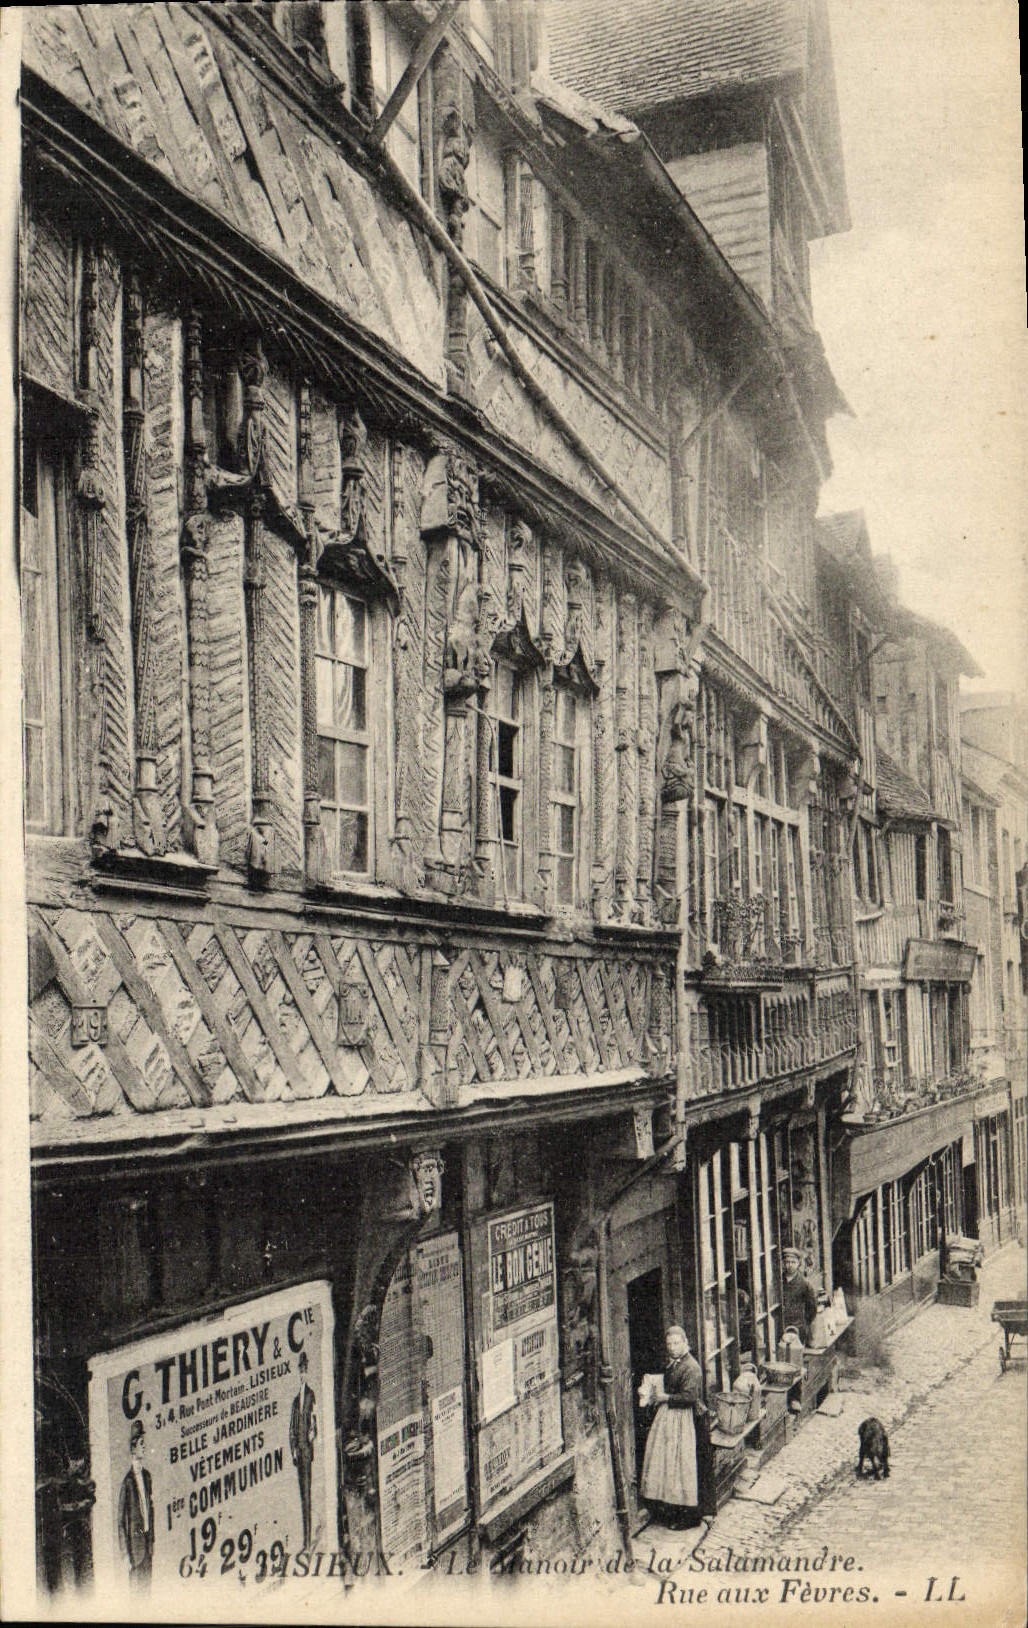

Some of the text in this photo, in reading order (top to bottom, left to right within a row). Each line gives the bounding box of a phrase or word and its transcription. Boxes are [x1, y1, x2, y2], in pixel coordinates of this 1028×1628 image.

[492, 1254, 505, 1293] LE
[506, 1246, 525, 1289] BON
[273, 1336, 282, 1360] &
[179, 1404, 195, 1420] Rue
[250, 1360, 291, 1389] LISIEUX
[220, 1408, 229, 1421] de
[230, 1387, 269, 1415] BEAUSIRE
[169, 1433, 208, 1465] BELLE
[189, 1446, 284, 1519] COMMUNION
